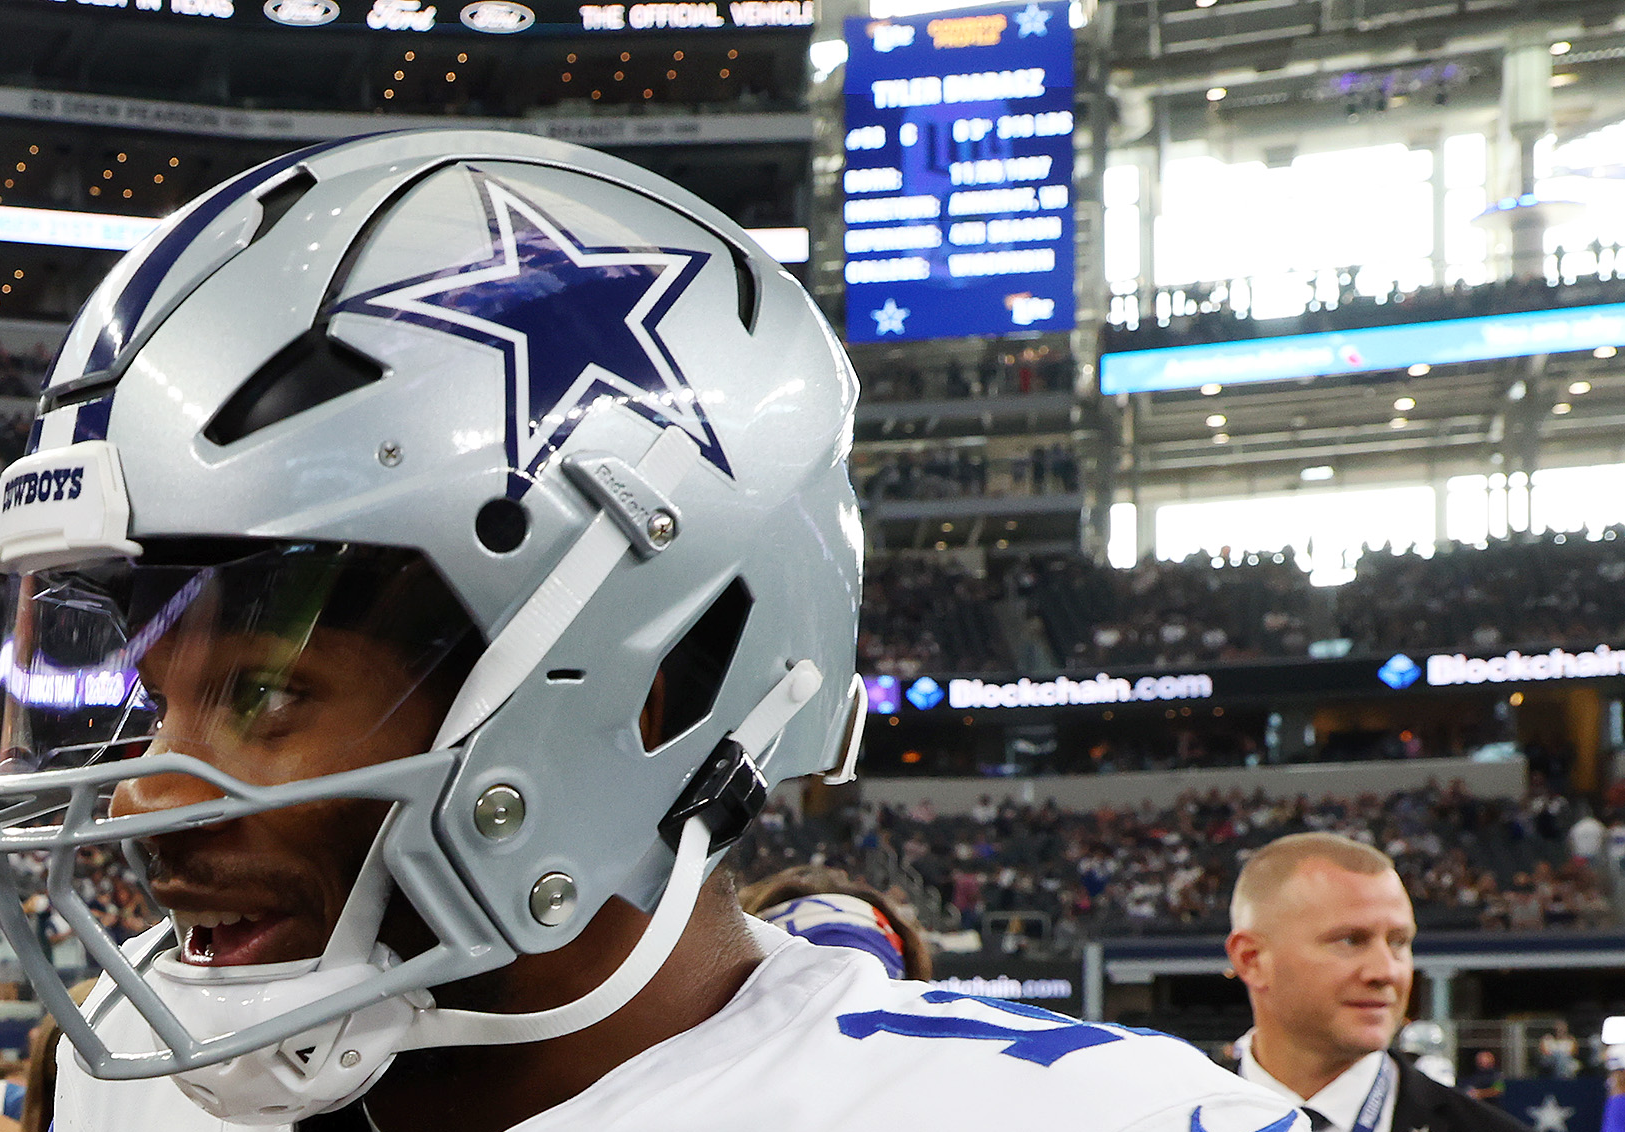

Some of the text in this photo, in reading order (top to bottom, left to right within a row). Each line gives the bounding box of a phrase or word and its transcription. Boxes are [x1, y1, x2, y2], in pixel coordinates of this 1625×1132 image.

[579, 4, 626, 31] THE
[628, 3, 726, 29] OFFICIAL
[949, 672, 1213, 708] Blockchain.com
